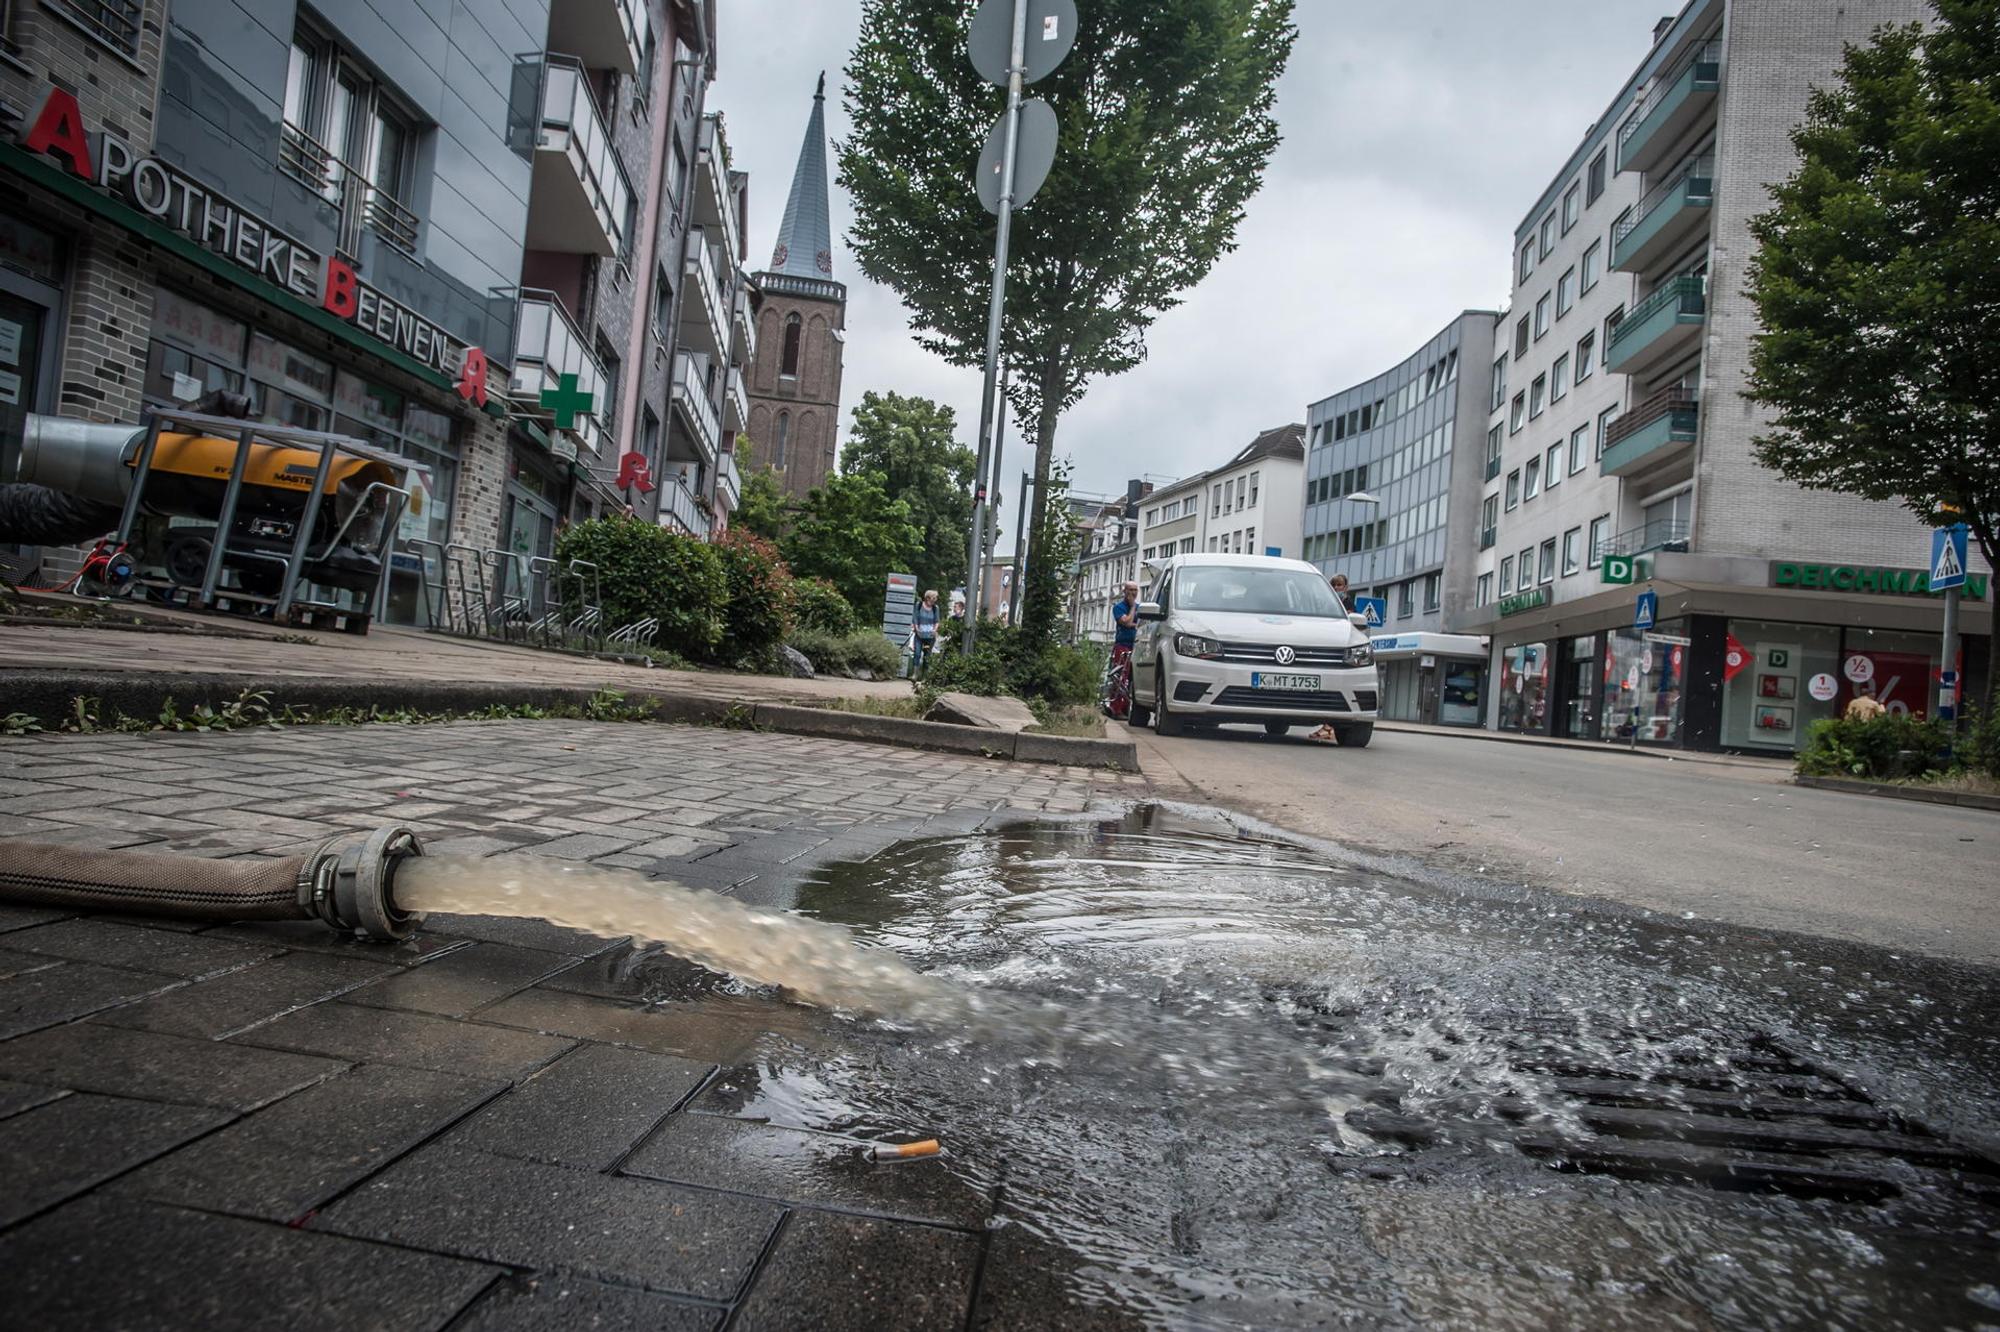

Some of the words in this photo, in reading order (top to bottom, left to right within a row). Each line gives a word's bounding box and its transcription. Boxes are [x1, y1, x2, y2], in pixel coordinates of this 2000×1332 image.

[25, 86, 311, 296] APOTHEKE
[324, 256, 448, 374] BEENEN
[273, 473, 313, 485] MASTE
[1610, 561, 1628, 578] D
[1775, 563, 1987, 599] DEICHMAN
[1259, 675, 1266, 685] K
[1274, 676, 1288, 686] MT
[1291, 677, 1319, 688] 1753
[1818, 676, 1826, 687] 1
